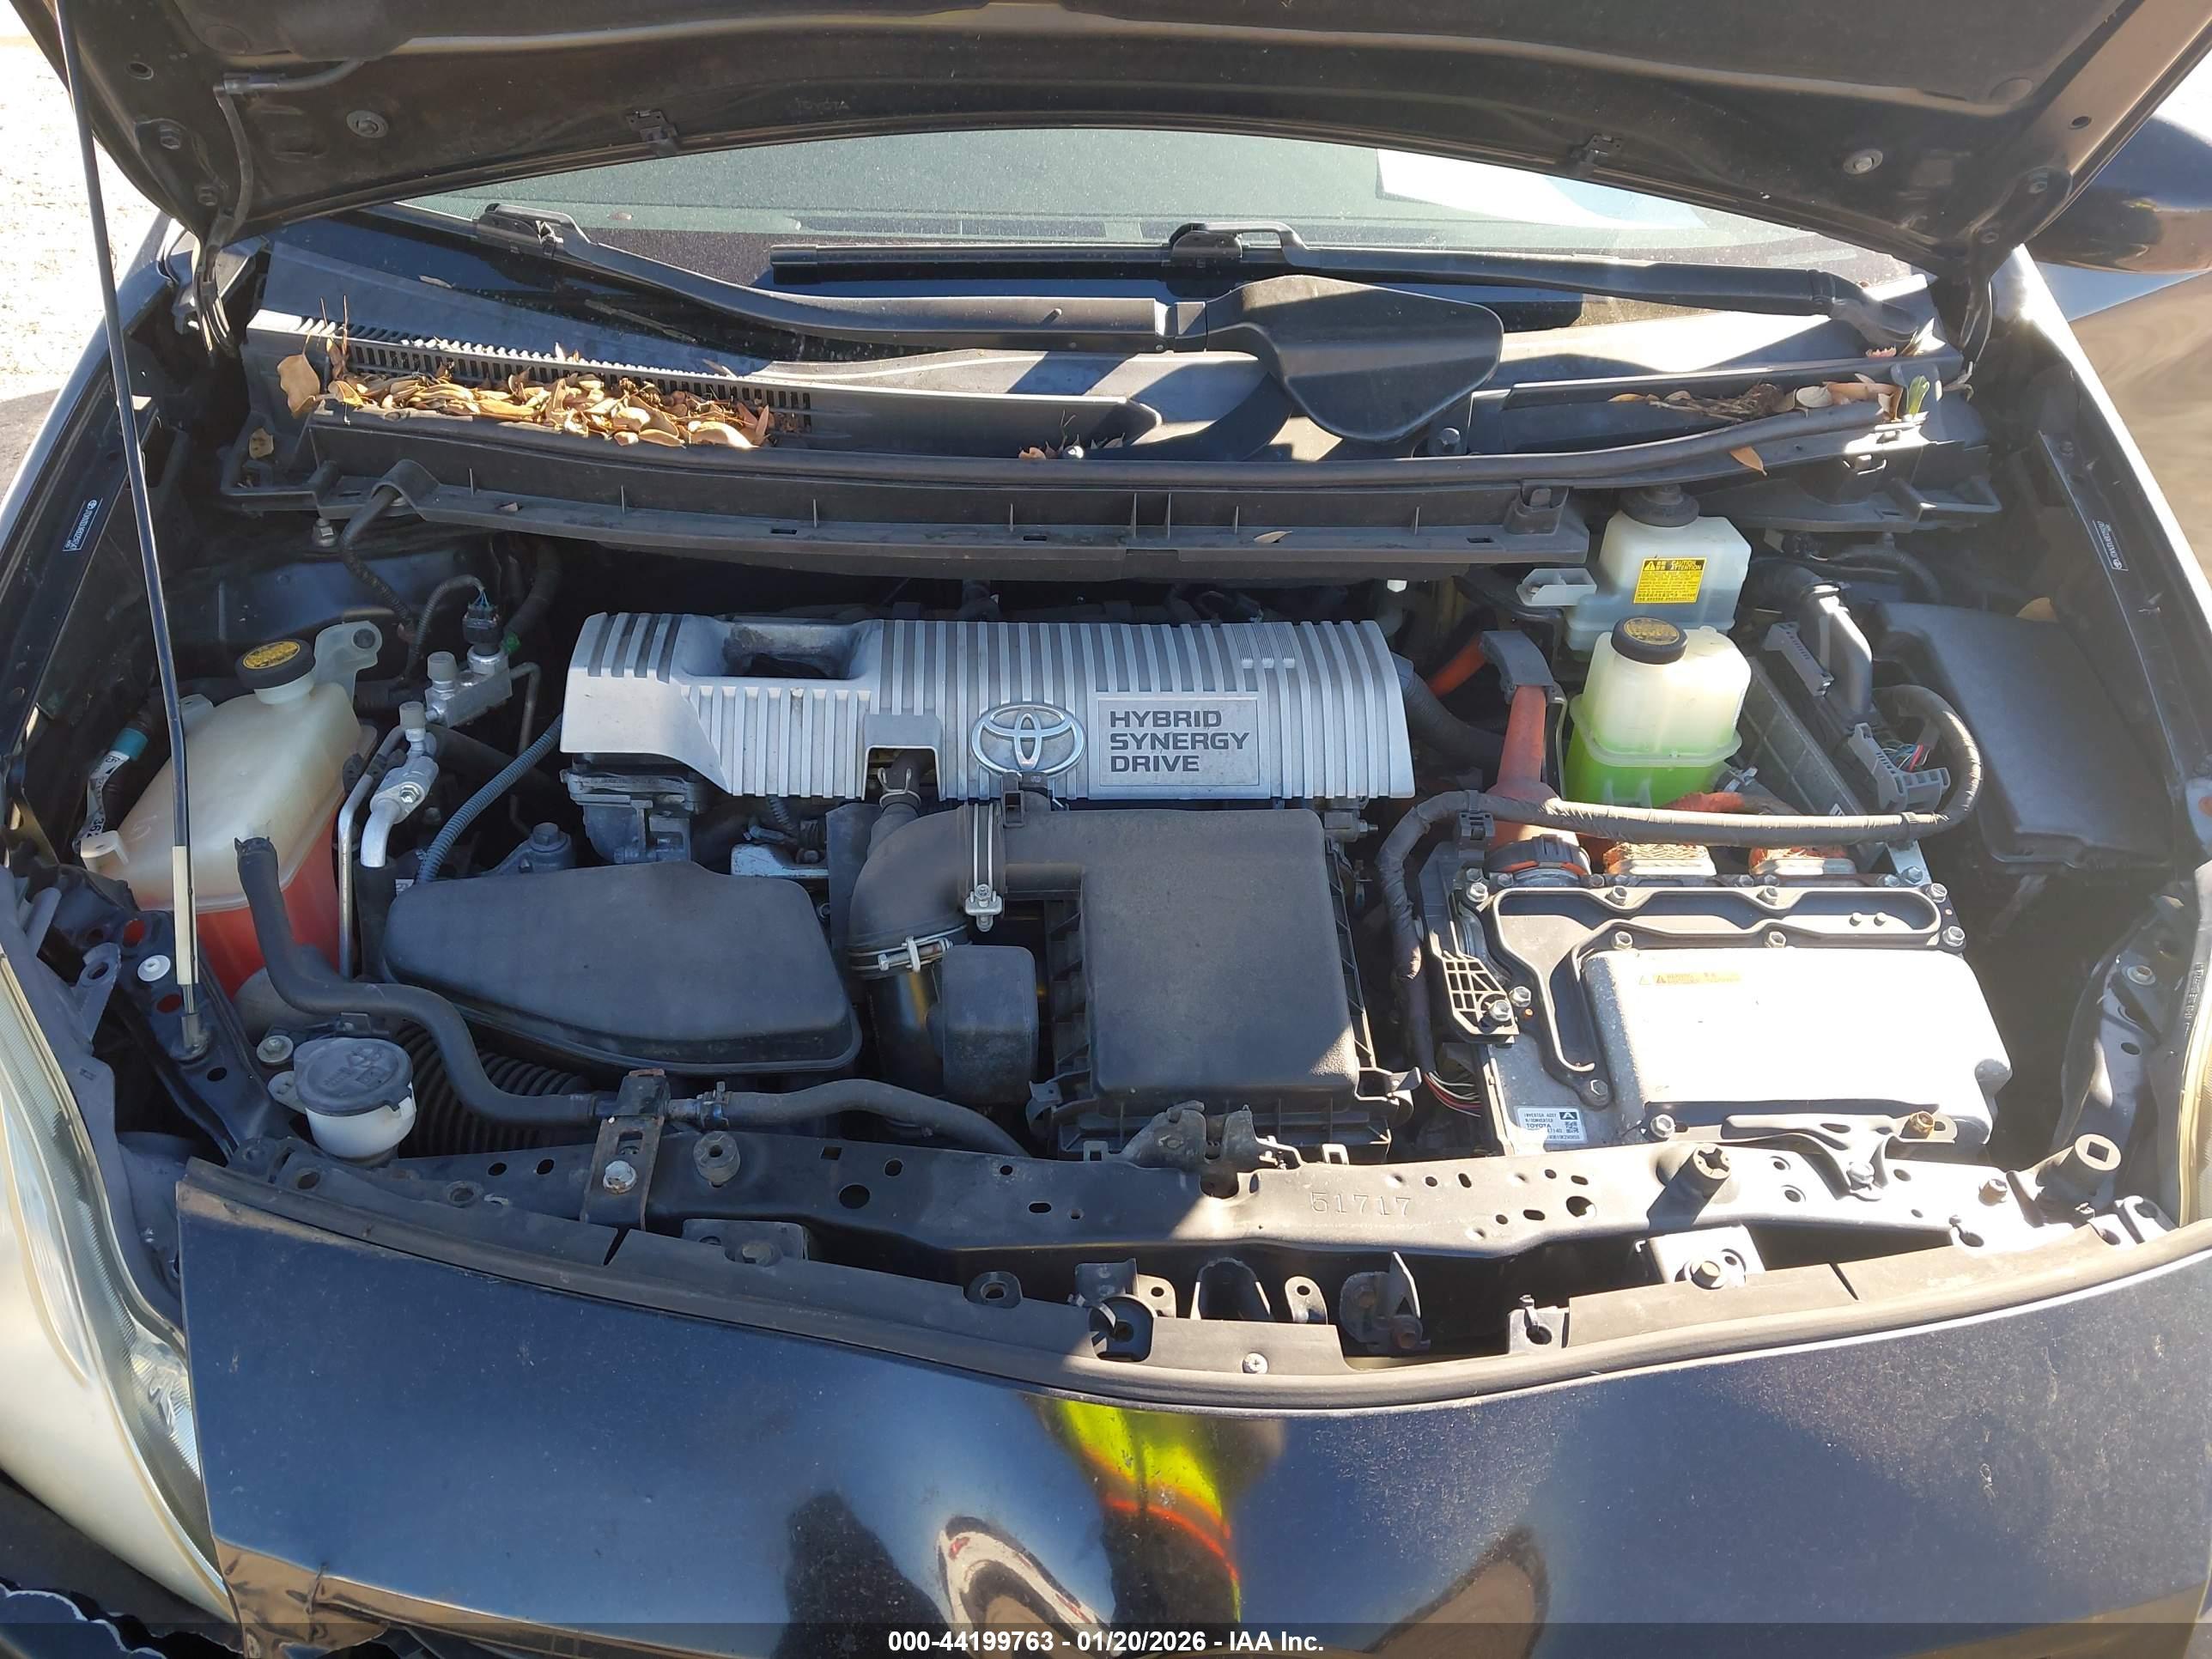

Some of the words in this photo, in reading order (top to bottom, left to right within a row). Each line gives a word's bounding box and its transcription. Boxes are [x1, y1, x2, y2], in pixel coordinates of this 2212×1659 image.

[1110, 711, 1221, 727] HYBRID
[1110, 732, 1249, 750] SYNERGY
[1110, 756, 1200, 772] DRIVE
[1310, 1191, 1411, 1216] 51717
